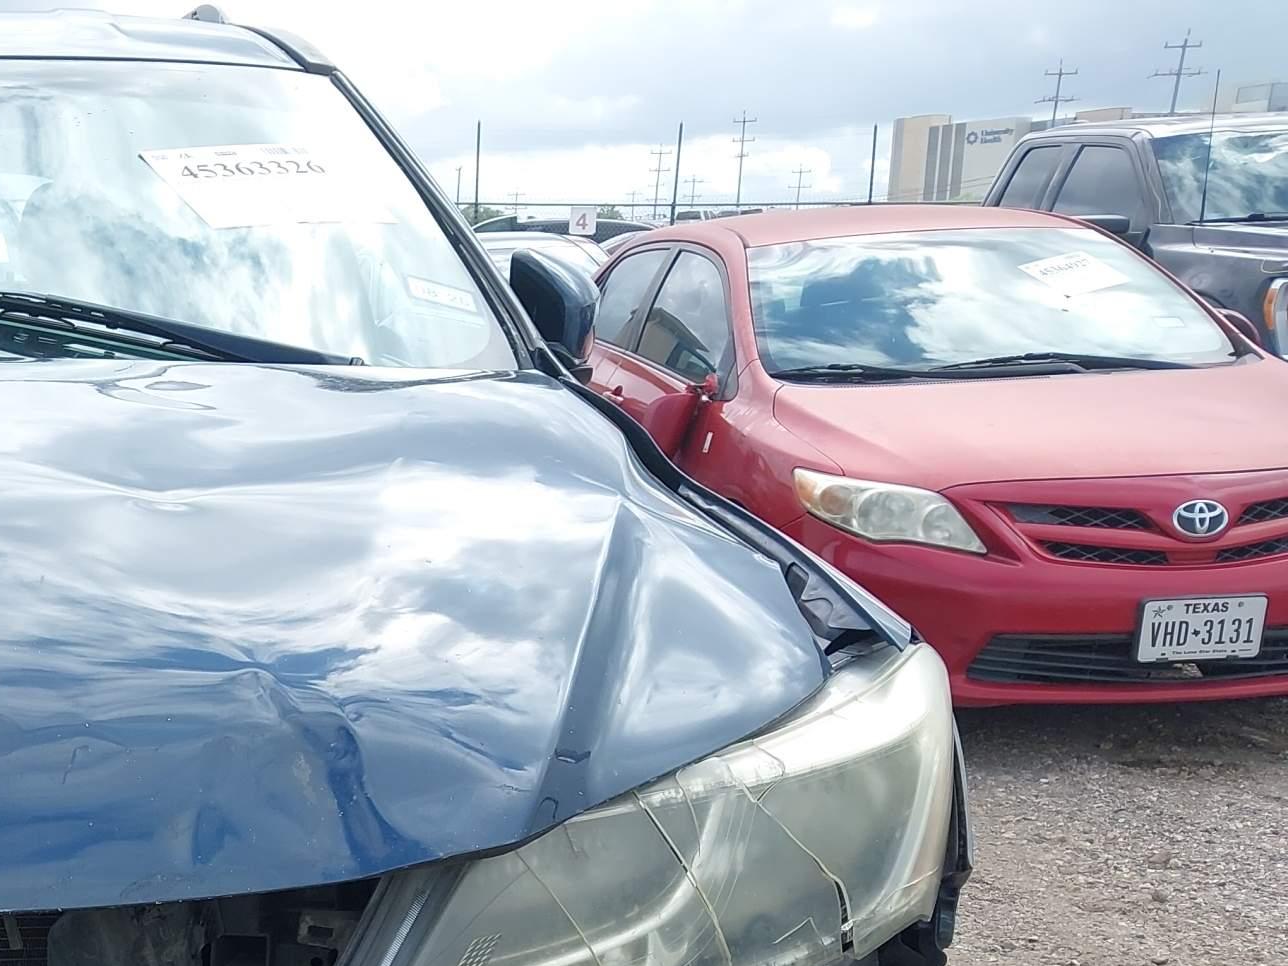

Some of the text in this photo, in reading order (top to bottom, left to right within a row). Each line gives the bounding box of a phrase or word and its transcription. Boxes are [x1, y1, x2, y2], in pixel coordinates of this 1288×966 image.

[181, 160, 326, 179] 45363326
[575, 212, 589, 230] 4
[1184, 602, 1229, 614] TEXAS
